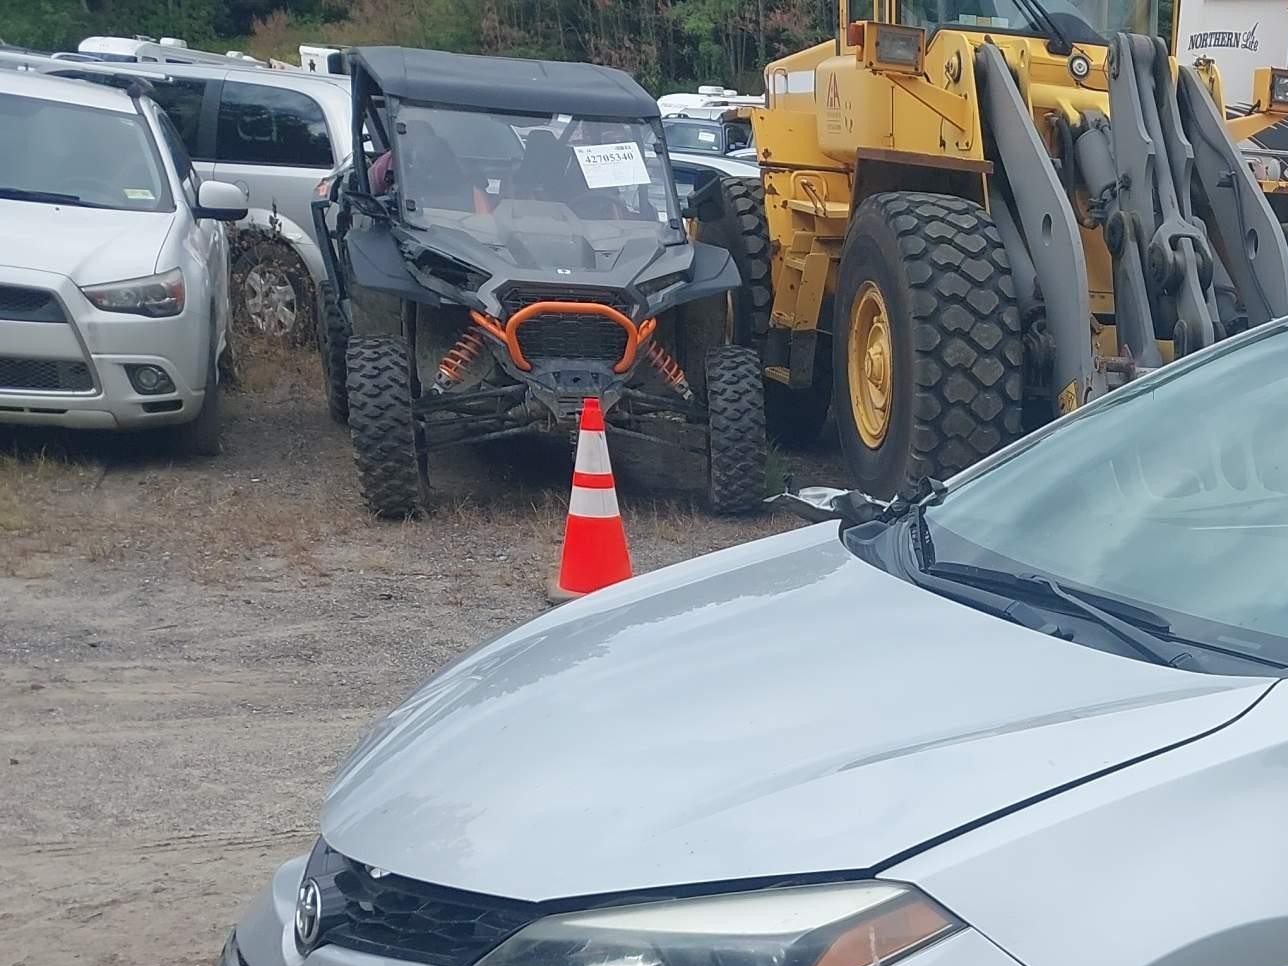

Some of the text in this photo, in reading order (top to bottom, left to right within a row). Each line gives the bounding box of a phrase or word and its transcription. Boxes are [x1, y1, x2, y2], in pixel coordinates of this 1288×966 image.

[1187, 22, 1259, 52] NORTHERN Lite
[586, 152, 634, 163] 42705340
